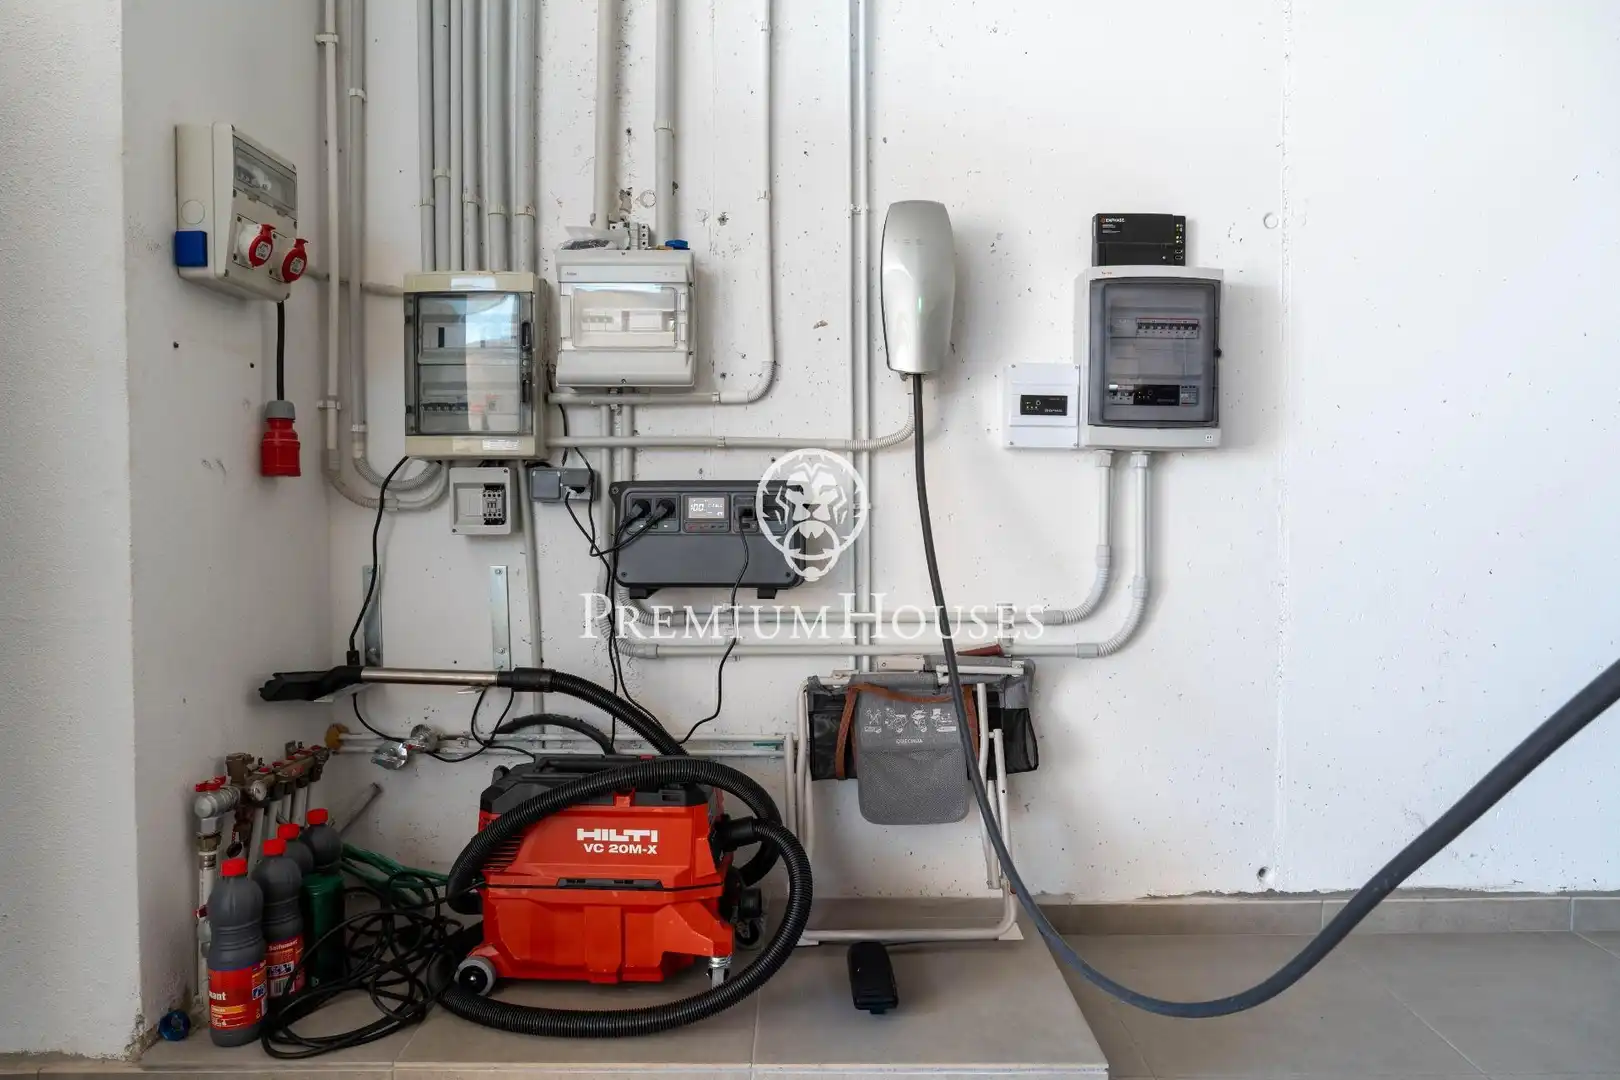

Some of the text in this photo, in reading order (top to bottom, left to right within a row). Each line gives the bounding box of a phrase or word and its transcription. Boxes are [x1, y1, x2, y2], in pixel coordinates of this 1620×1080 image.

[576, 828, 658, 843] HILTI
[583, 843, 659, 856] VC 20M-X
